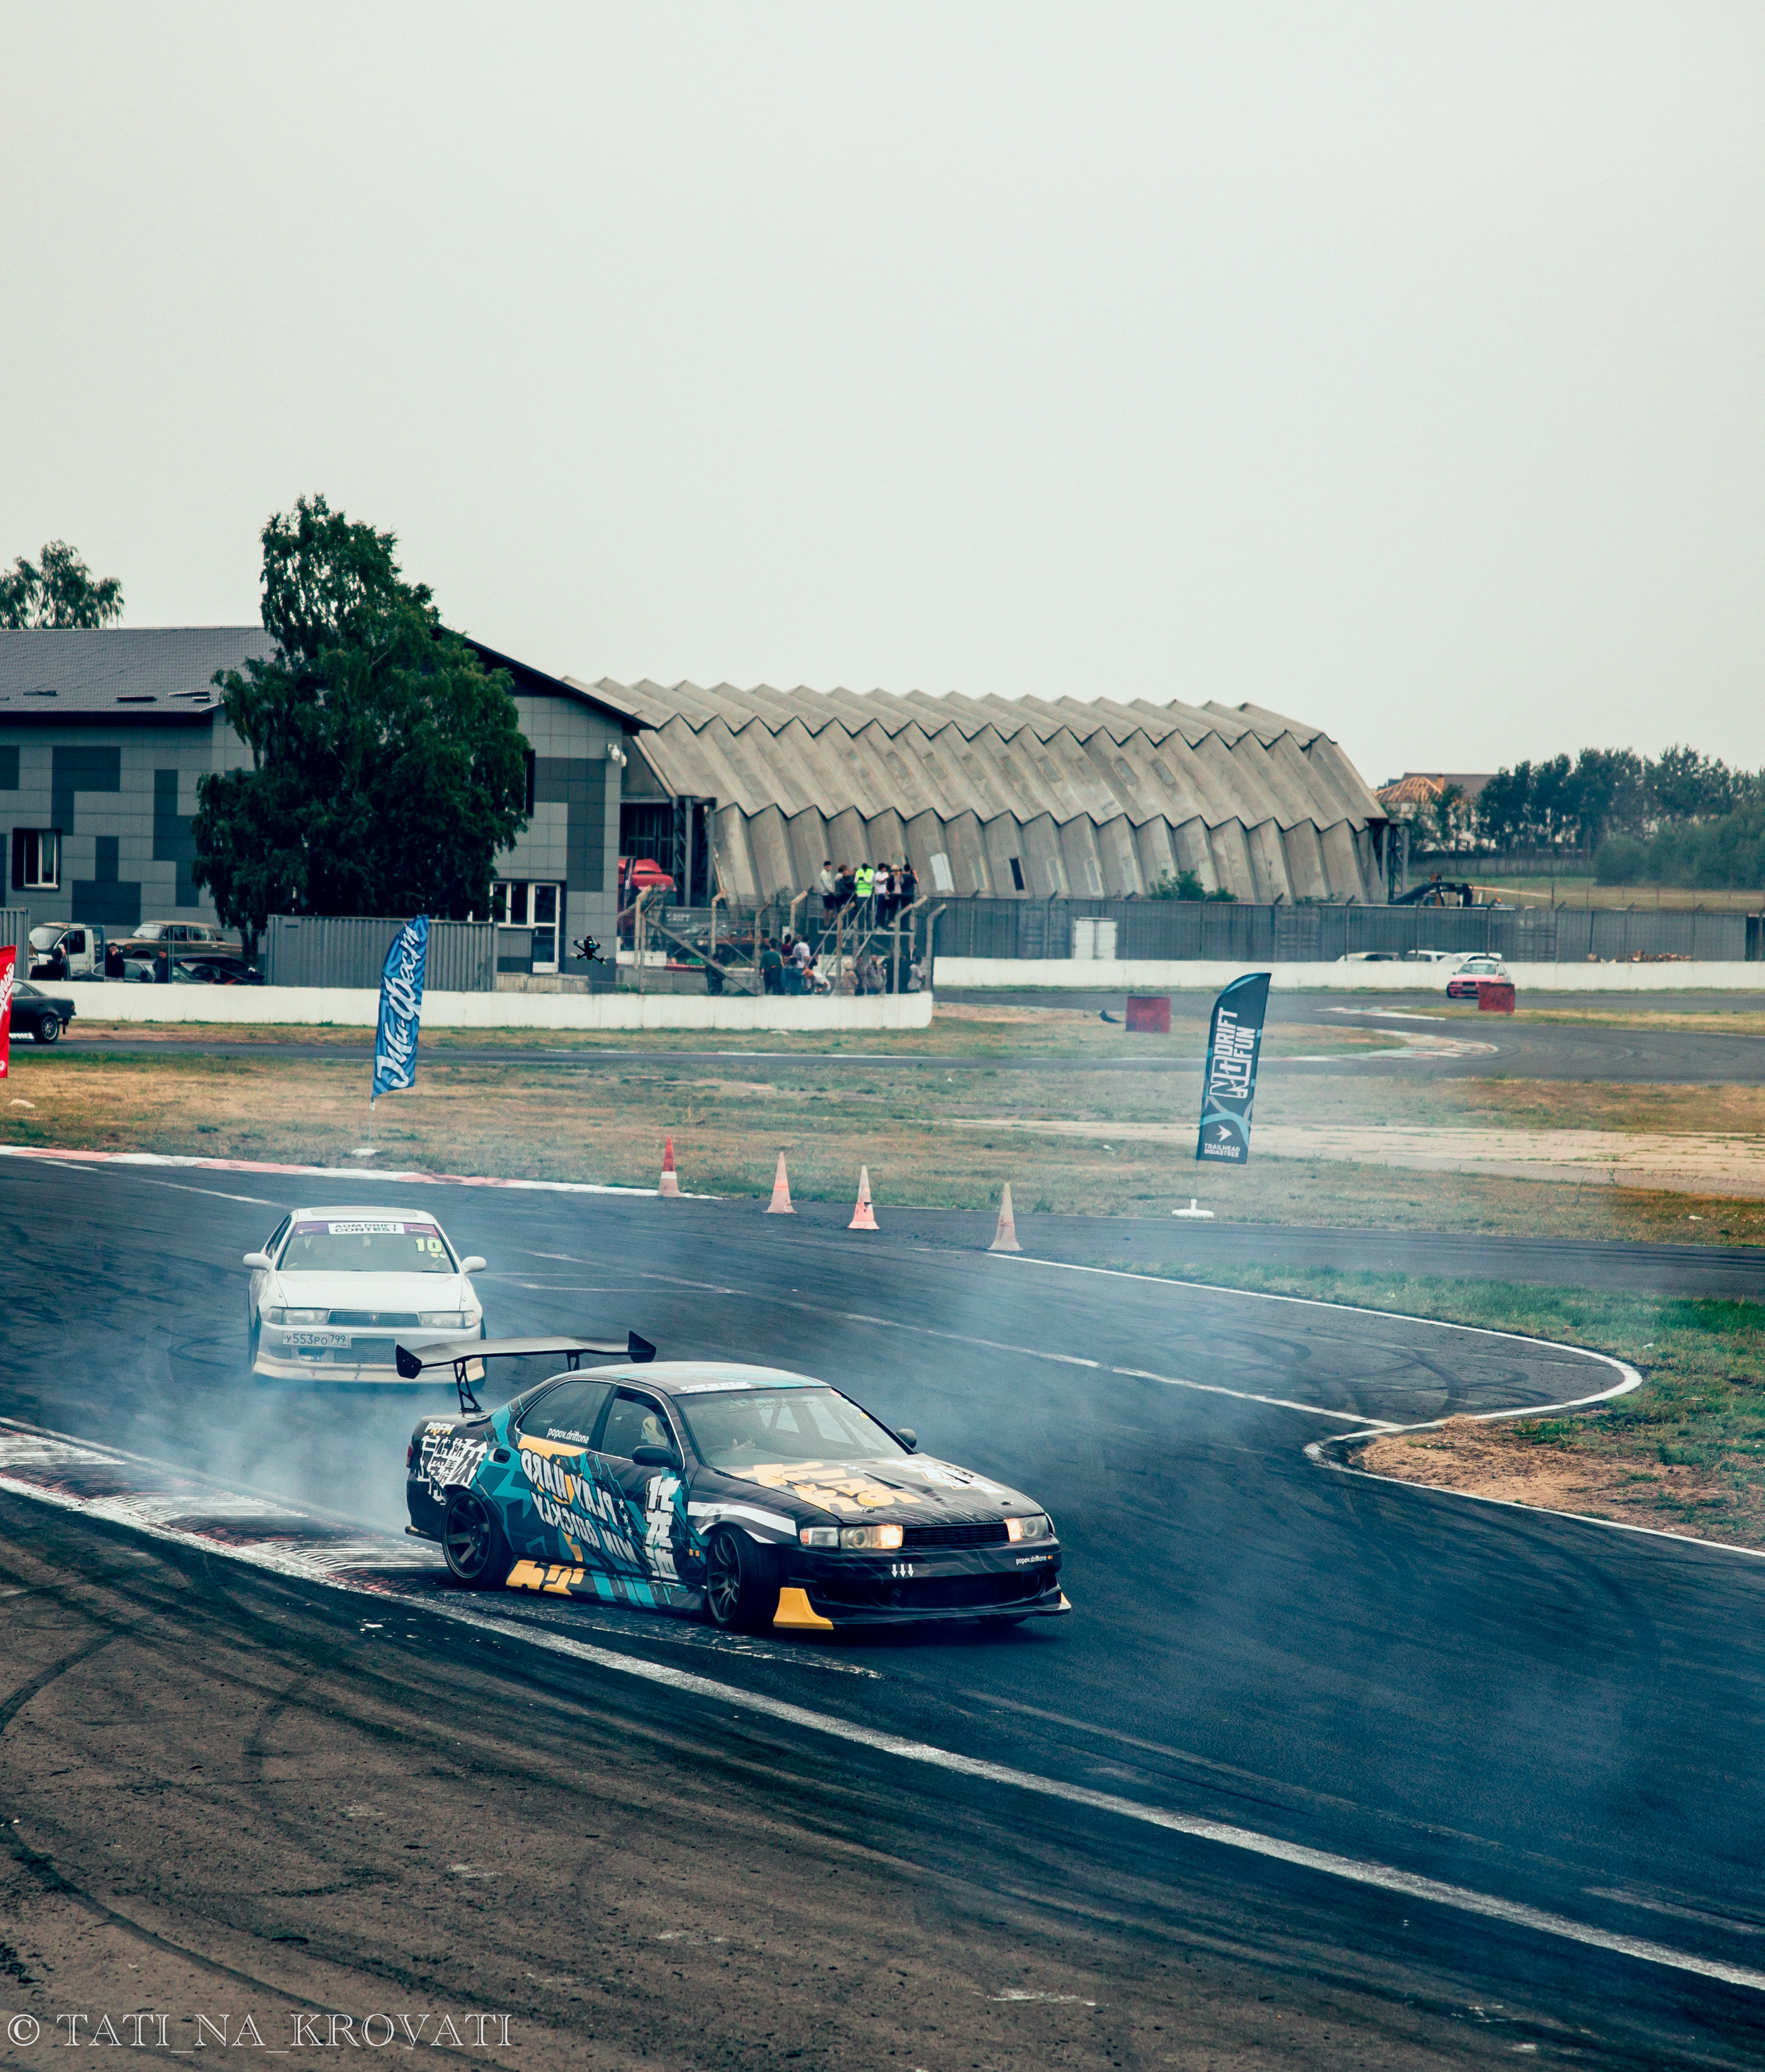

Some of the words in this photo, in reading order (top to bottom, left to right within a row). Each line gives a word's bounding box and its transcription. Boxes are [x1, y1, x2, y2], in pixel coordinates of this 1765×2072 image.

[1213, 1006, 1238, 1057] DRIFT
[1233, 1026, 1256, 1059] FUN
[1204, 1143, 1240, 1152] TRAILHEAD
[1204, 1148, 1240, 1158] INDASTREE
[416, 1239, 443, 1252] 10
[424, 1421, 456, 1436] PRFM
[546, 1428, 589, 1444] popov.driftone
